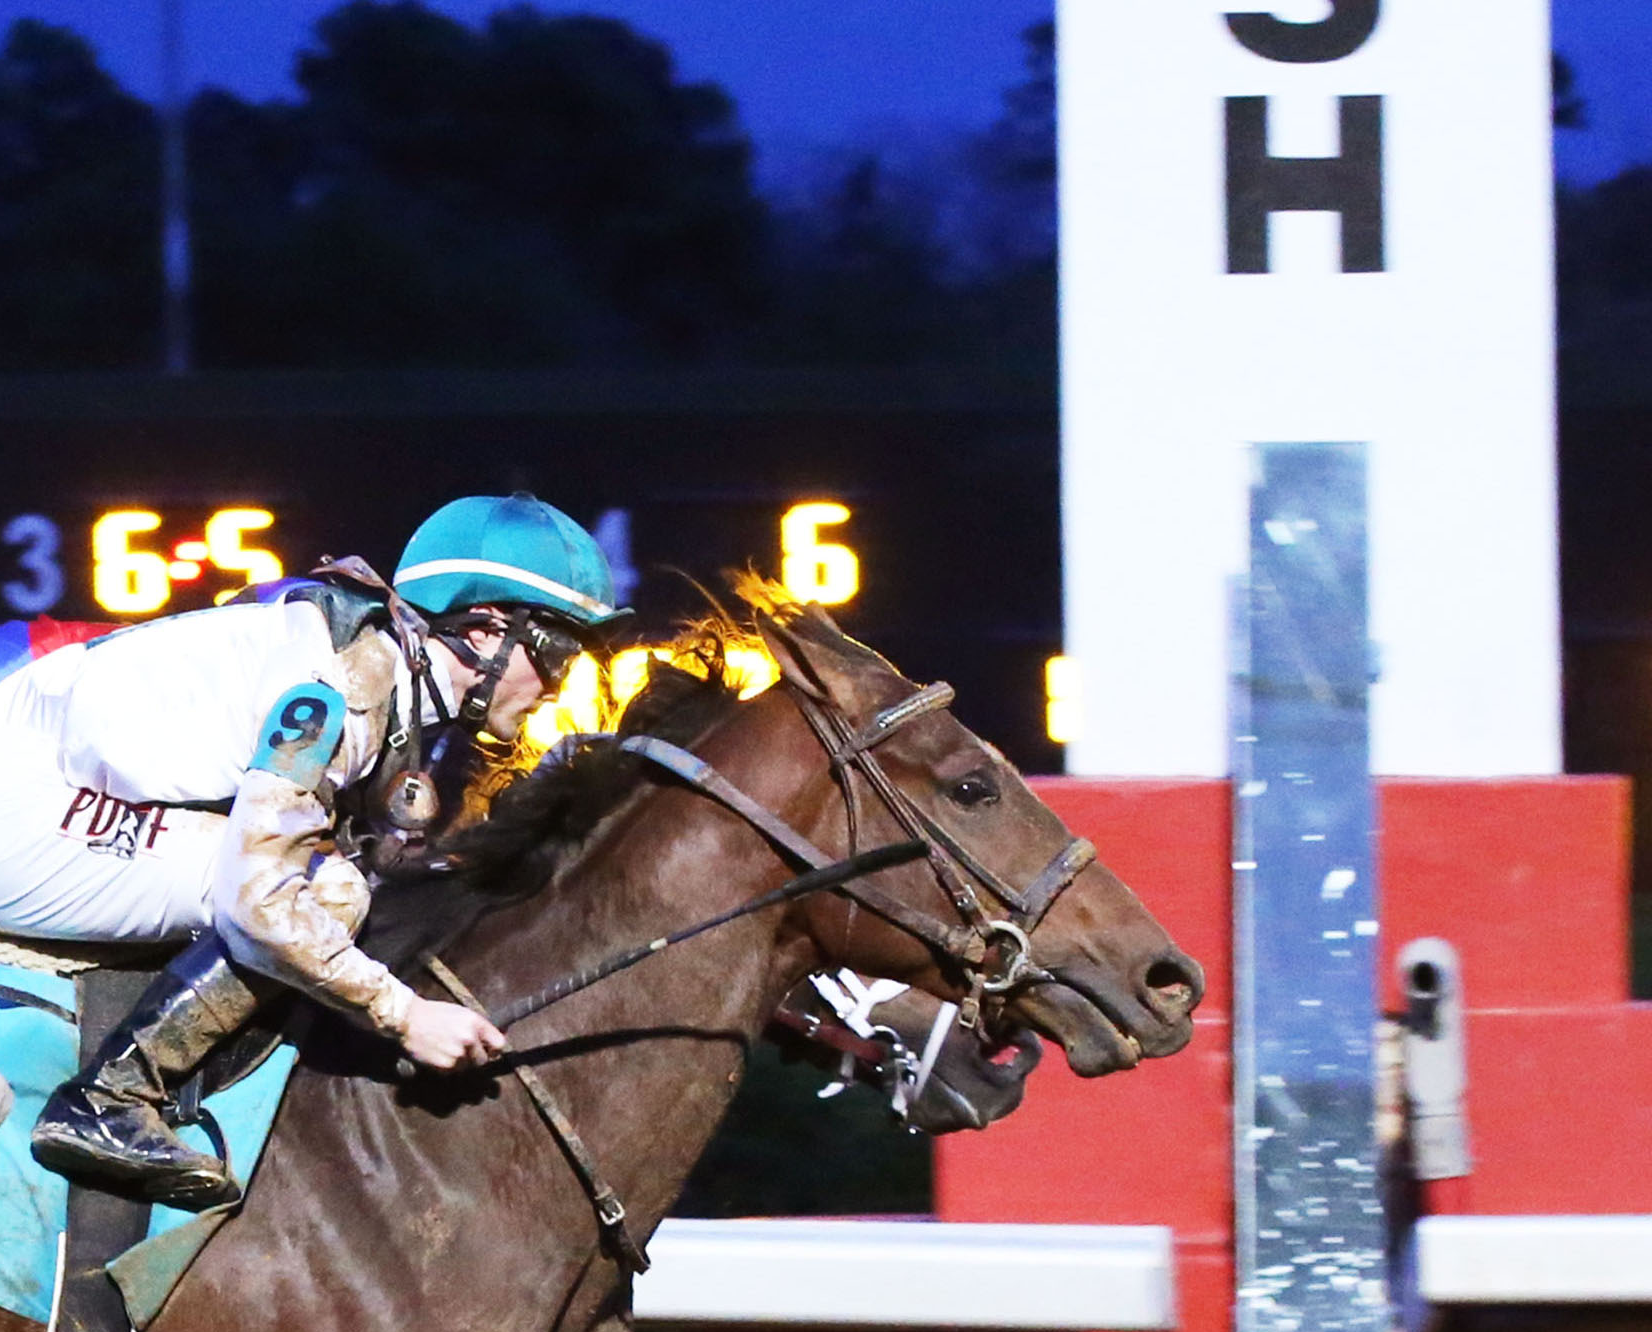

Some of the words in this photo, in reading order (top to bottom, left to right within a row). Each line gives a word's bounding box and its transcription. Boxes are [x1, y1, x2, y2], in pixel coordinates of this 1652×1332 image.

[2, 514, 64, 612] 3
[780, 502, 860, 606] 6
[269, 697, 328, 751] 9
